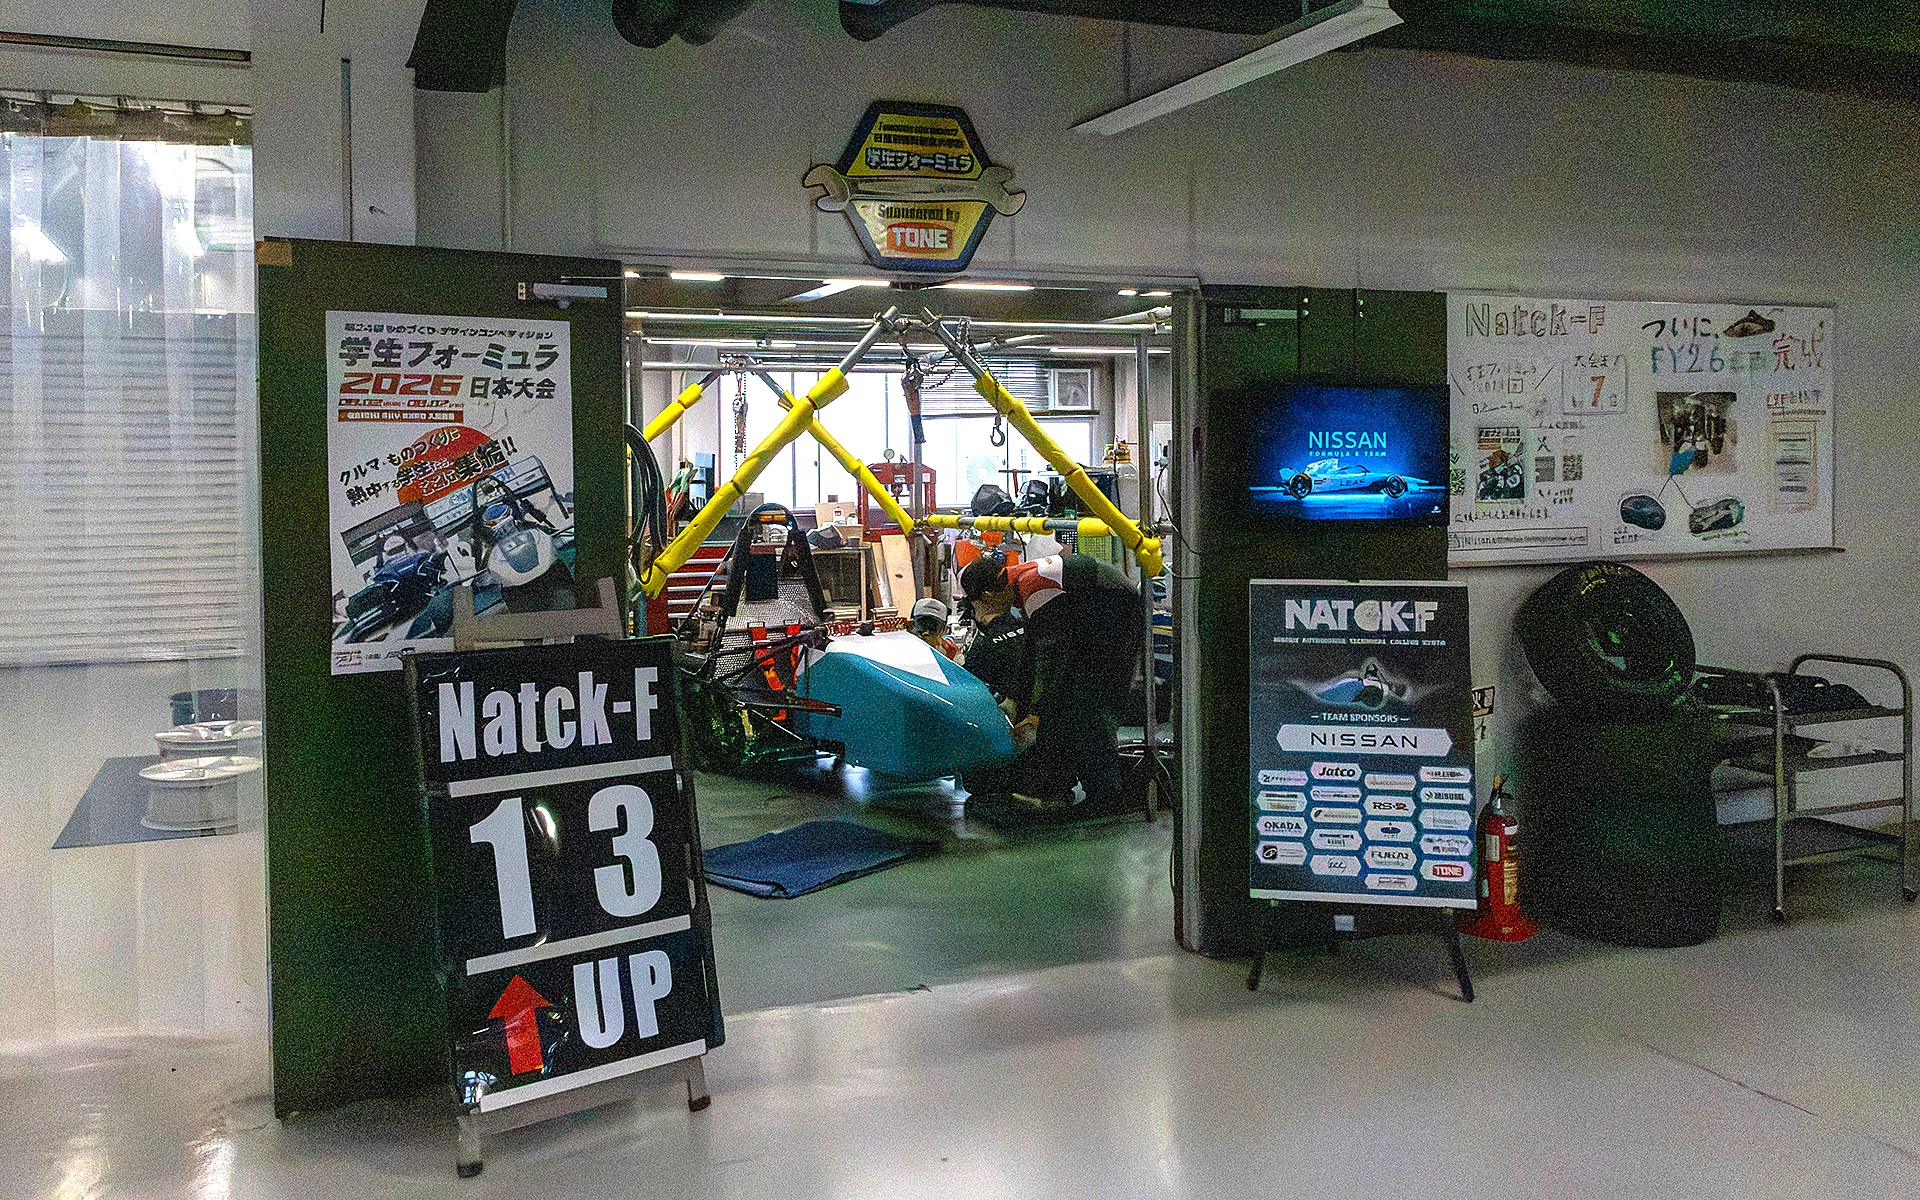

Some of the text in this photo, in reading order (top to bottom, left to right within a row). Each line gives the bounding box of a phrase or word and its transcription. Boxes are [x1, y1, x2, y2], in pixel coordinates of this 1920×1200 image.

[865, 147, 974, 173] 学生フォーミュラ
[892, 227, 948, 249] TONE
[1466, 303, 1606, 337] Natck-F
[339, 336, 560, 371] 学生フォーミュラ
[339, 372, 557, 399] 2026 日本大会
[1308, 431, 1387, 449] NISSAN
[437, 667, 659, 763] Natck-F
[1322, 713, 1398, 723] TEAM SPONSORS
[1310, 732, 1418, 749] NISSAN
[1318, 765, 1356, 779] Jatco
[1264, 821, 1302, 831] OKADA
[1433, 865, 1464, 878] TONE
[572, 950, 673, 1050] UP
